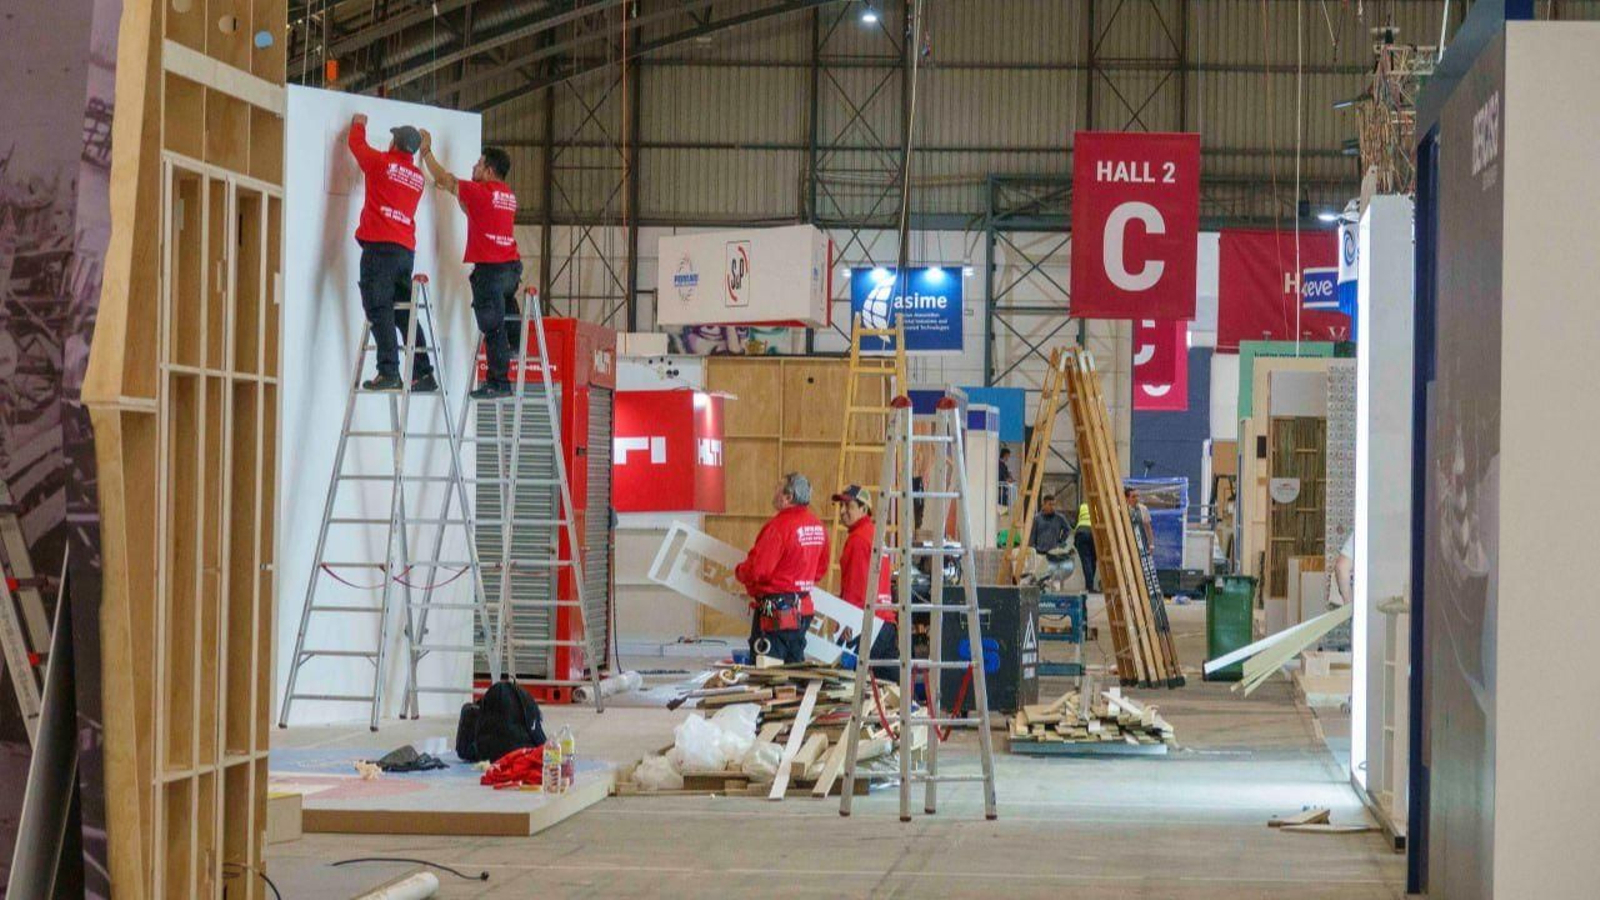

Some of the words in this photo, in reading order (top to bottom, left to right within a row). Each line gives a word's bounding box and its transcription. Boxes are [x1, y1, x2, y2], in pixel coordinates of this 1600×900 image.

[1096, 160, 1156, 182] HALL
[1162, 162, 1176, 183] 2
[1102, 200, 1166, 292] C
[893, 291, 948, 310] asime
